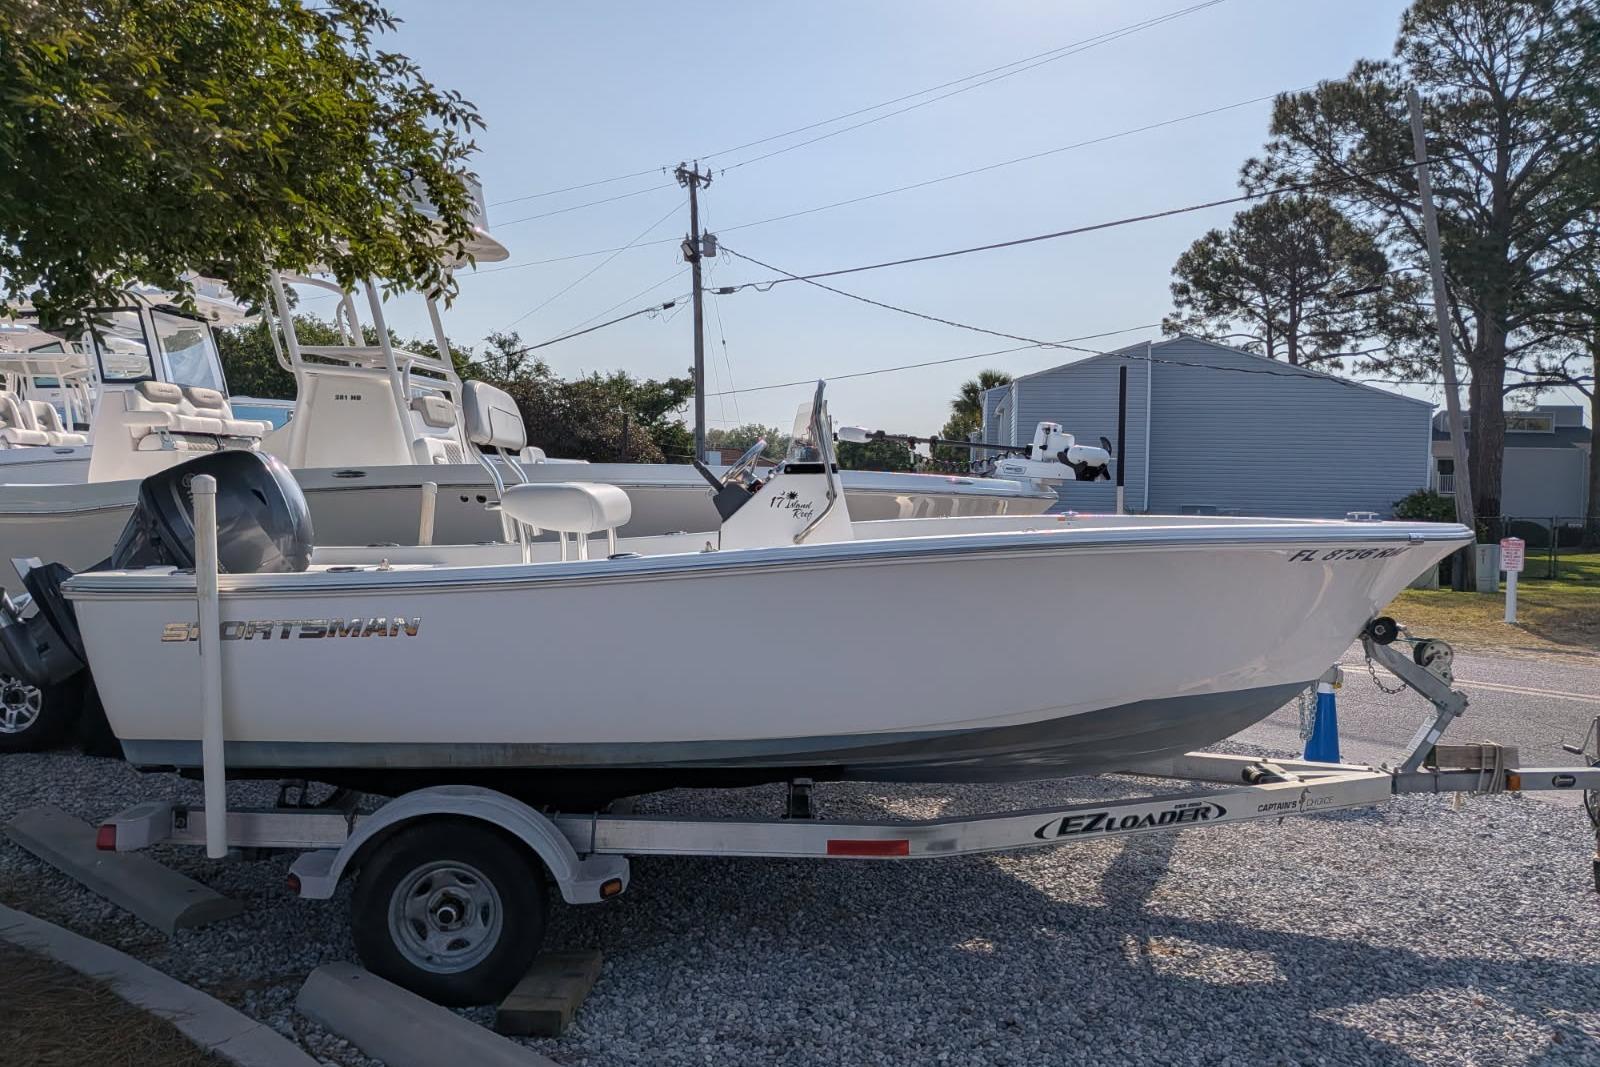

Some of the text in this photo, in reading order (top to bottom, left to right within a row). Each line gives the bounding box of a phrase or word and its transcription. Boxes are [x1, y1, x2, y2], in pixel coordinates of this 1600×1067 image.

[770, 496, 813, 509] 17 Island
[792, 508, 814, 521] Reef
[1288, 549, 1319, 562] FL
[1257, 800, 1298, 813] CAPTAIN'S
